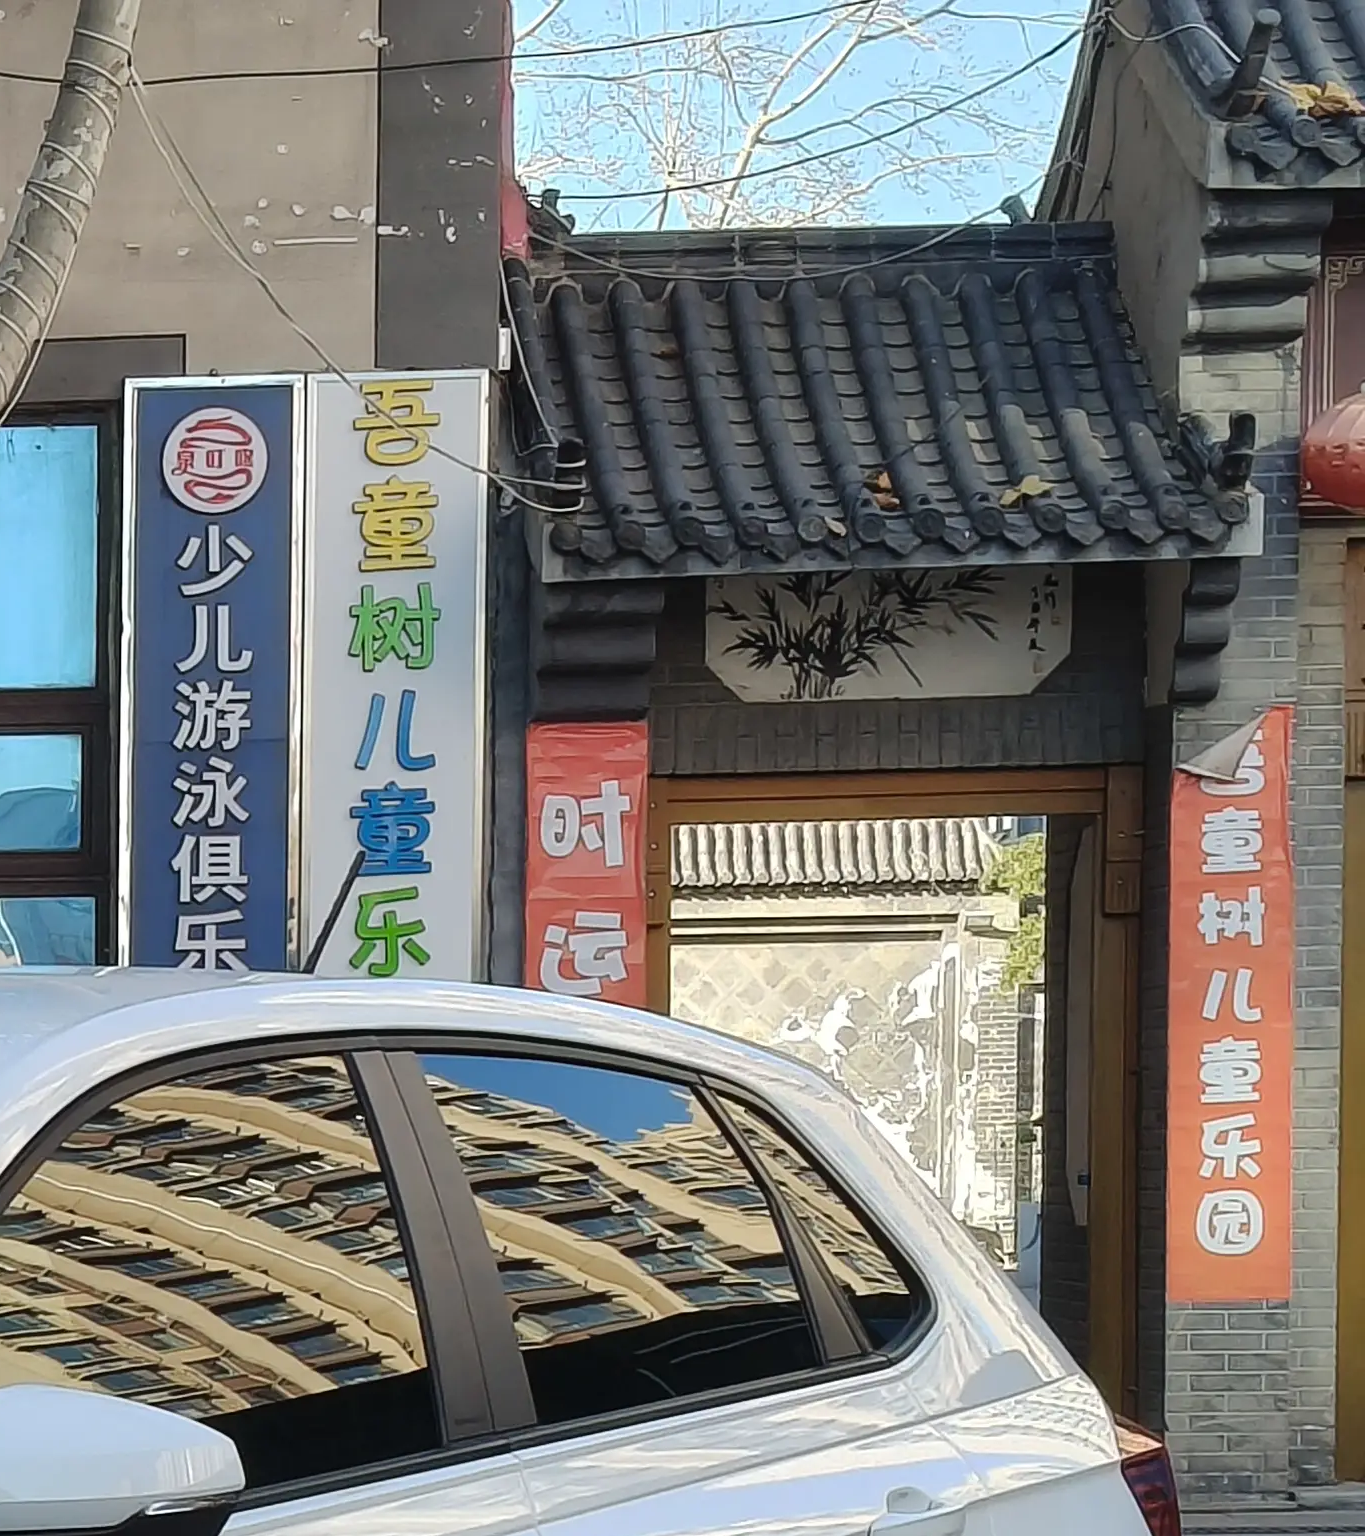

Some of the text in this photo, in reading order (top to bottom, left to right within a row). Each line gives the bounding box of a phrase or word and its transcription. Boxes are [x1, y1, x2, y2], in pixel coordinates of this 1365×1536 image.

[171, 523, 254, 972] 少儿游泳俱乐
[349, 379, 441, 977] 吾童树儿童乐
[539, 779, 631, 997] 时运
